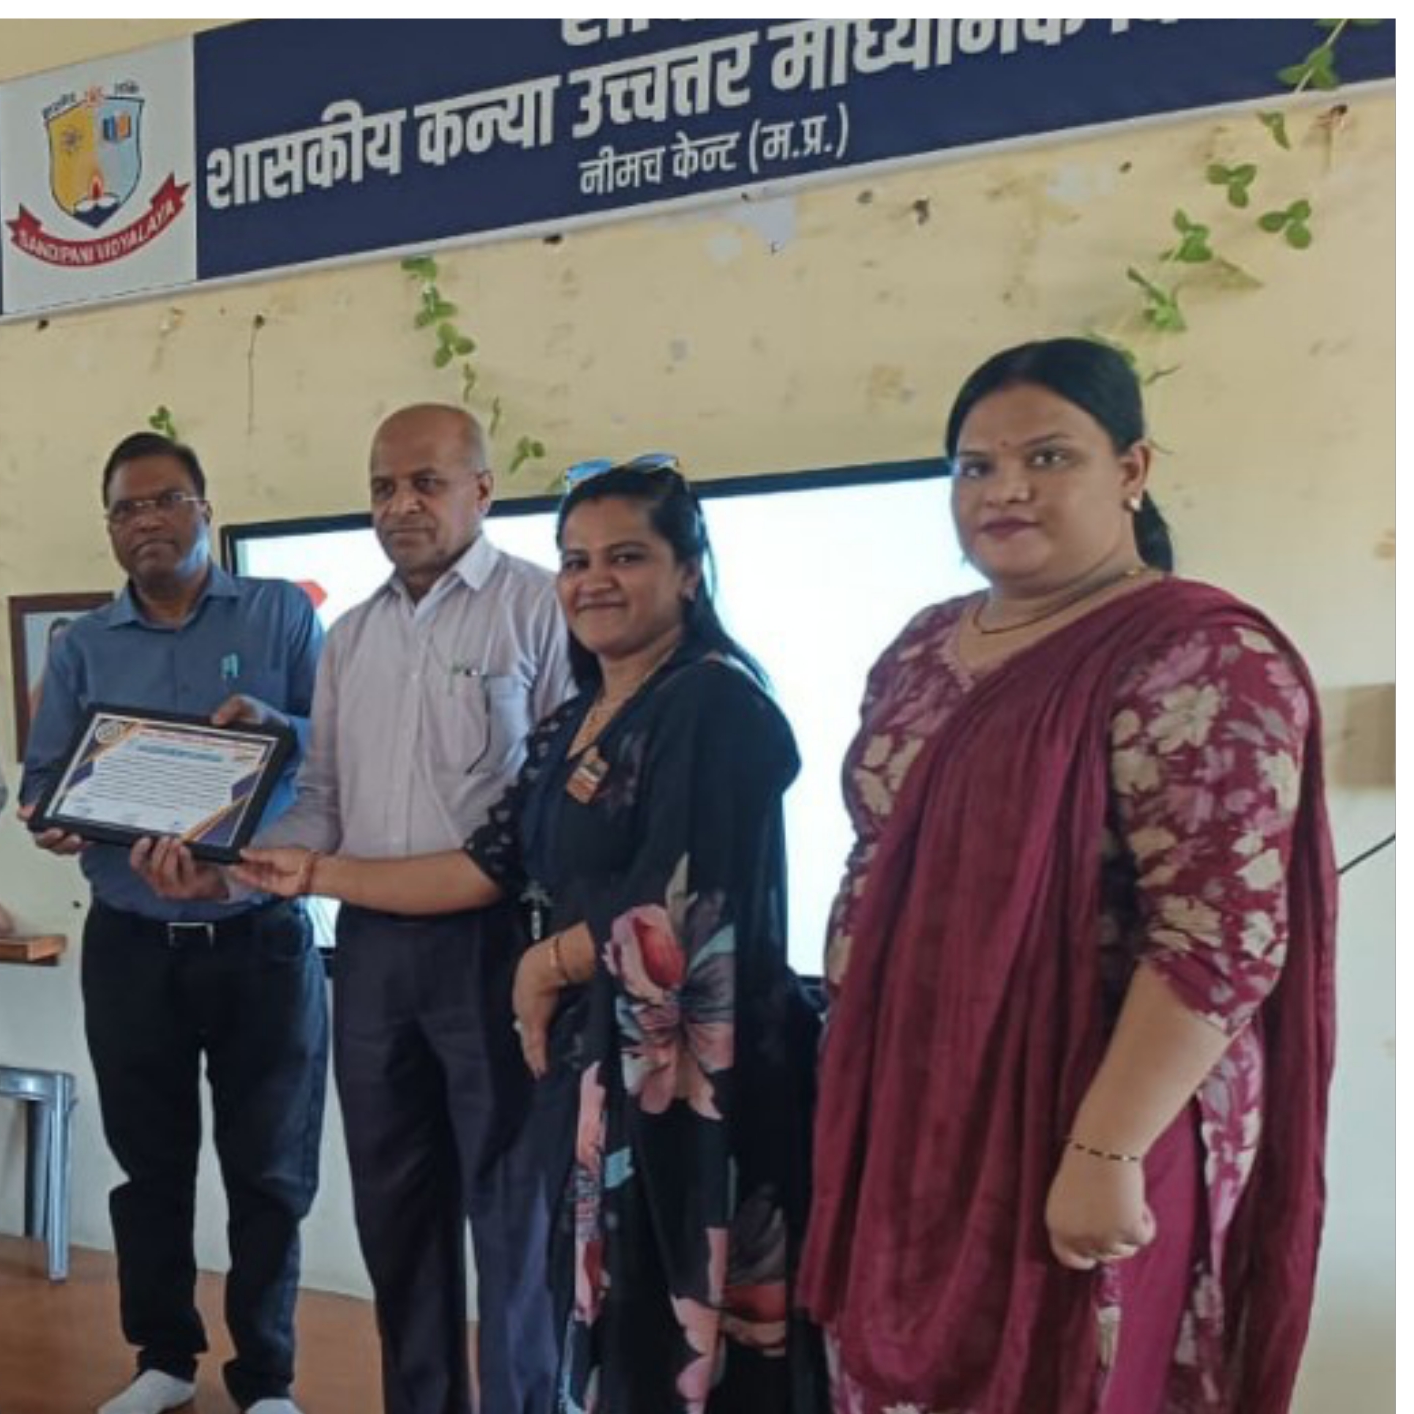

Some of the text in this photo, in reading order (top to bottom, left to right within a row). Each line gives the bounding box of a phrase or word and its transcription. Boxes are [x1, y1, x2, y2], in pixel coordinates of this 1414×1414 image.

[205, 99, 407, 210] शासकीय
[414, 75, 561, 166] कन्या
[577, 102, 849, 195] नीमच केन्ट (म.प्र.)
[97, 199, 176, 261] VIDYALAYA
